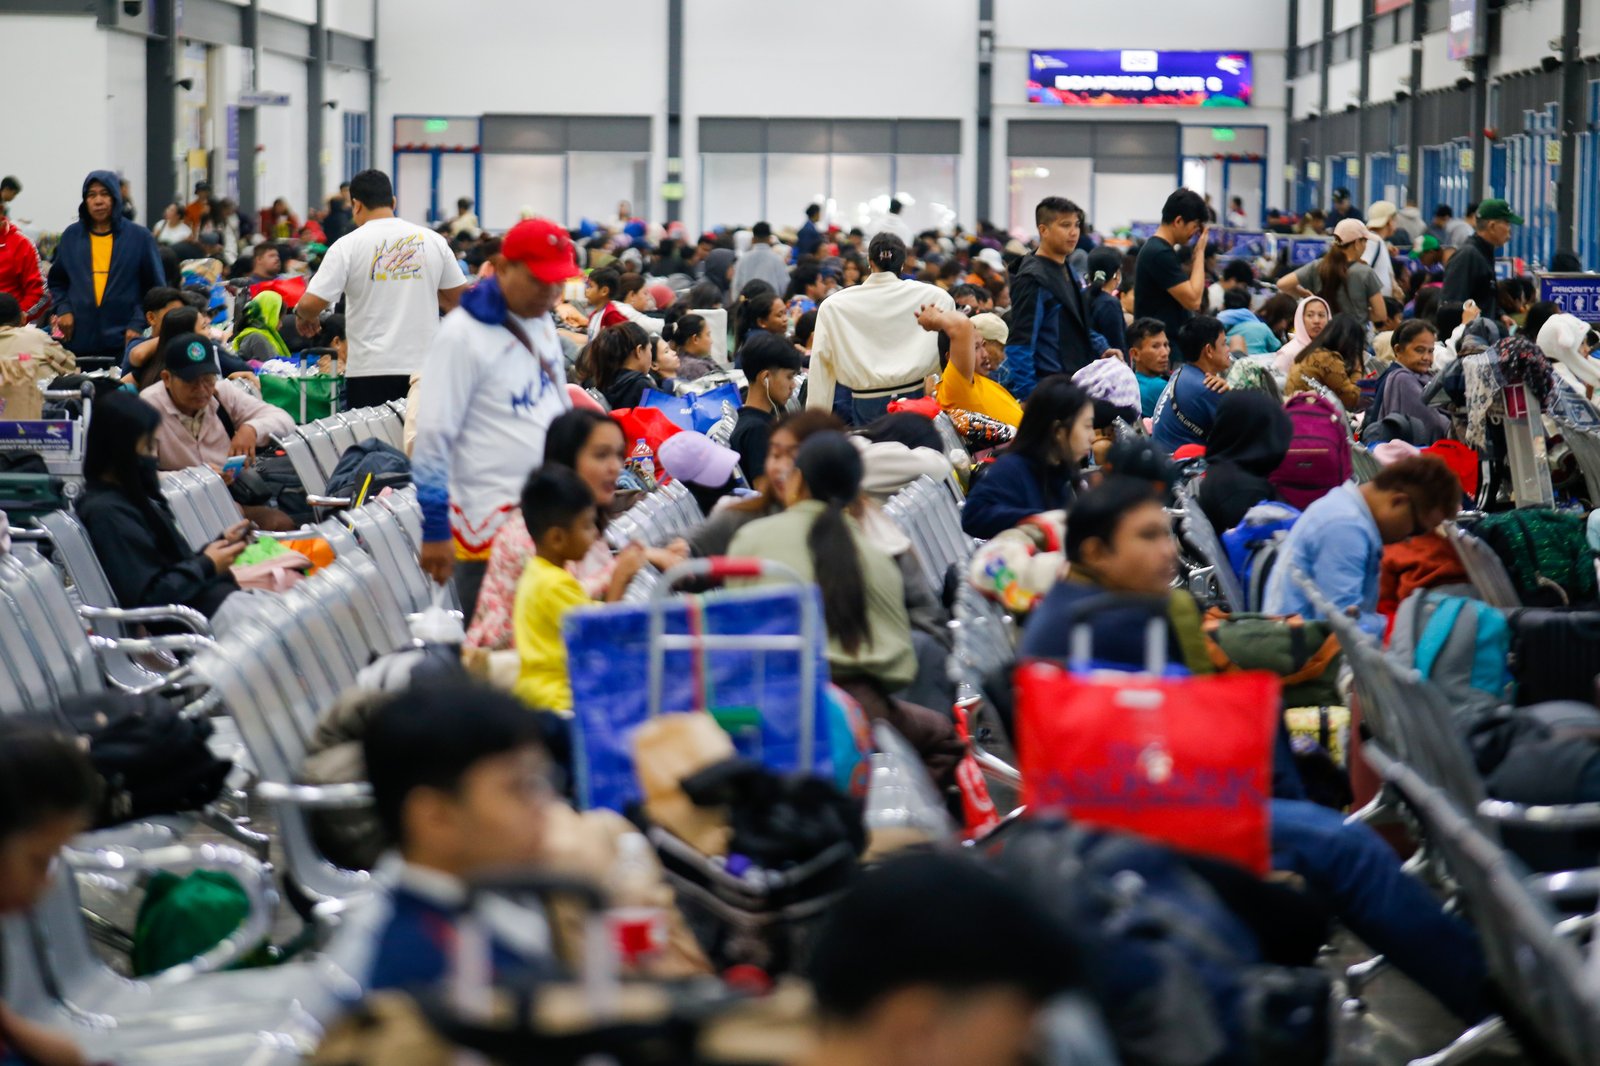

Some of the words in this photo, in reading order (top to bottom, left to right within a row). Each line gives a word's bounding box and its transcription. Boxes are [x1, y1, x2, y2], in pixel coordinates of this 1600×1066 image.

[1055, 75, 1154, 91] BOARDING
[1154, 76, 1205, 91] GATE
[1176, 410, 1204, 436] VOLUNTEER
